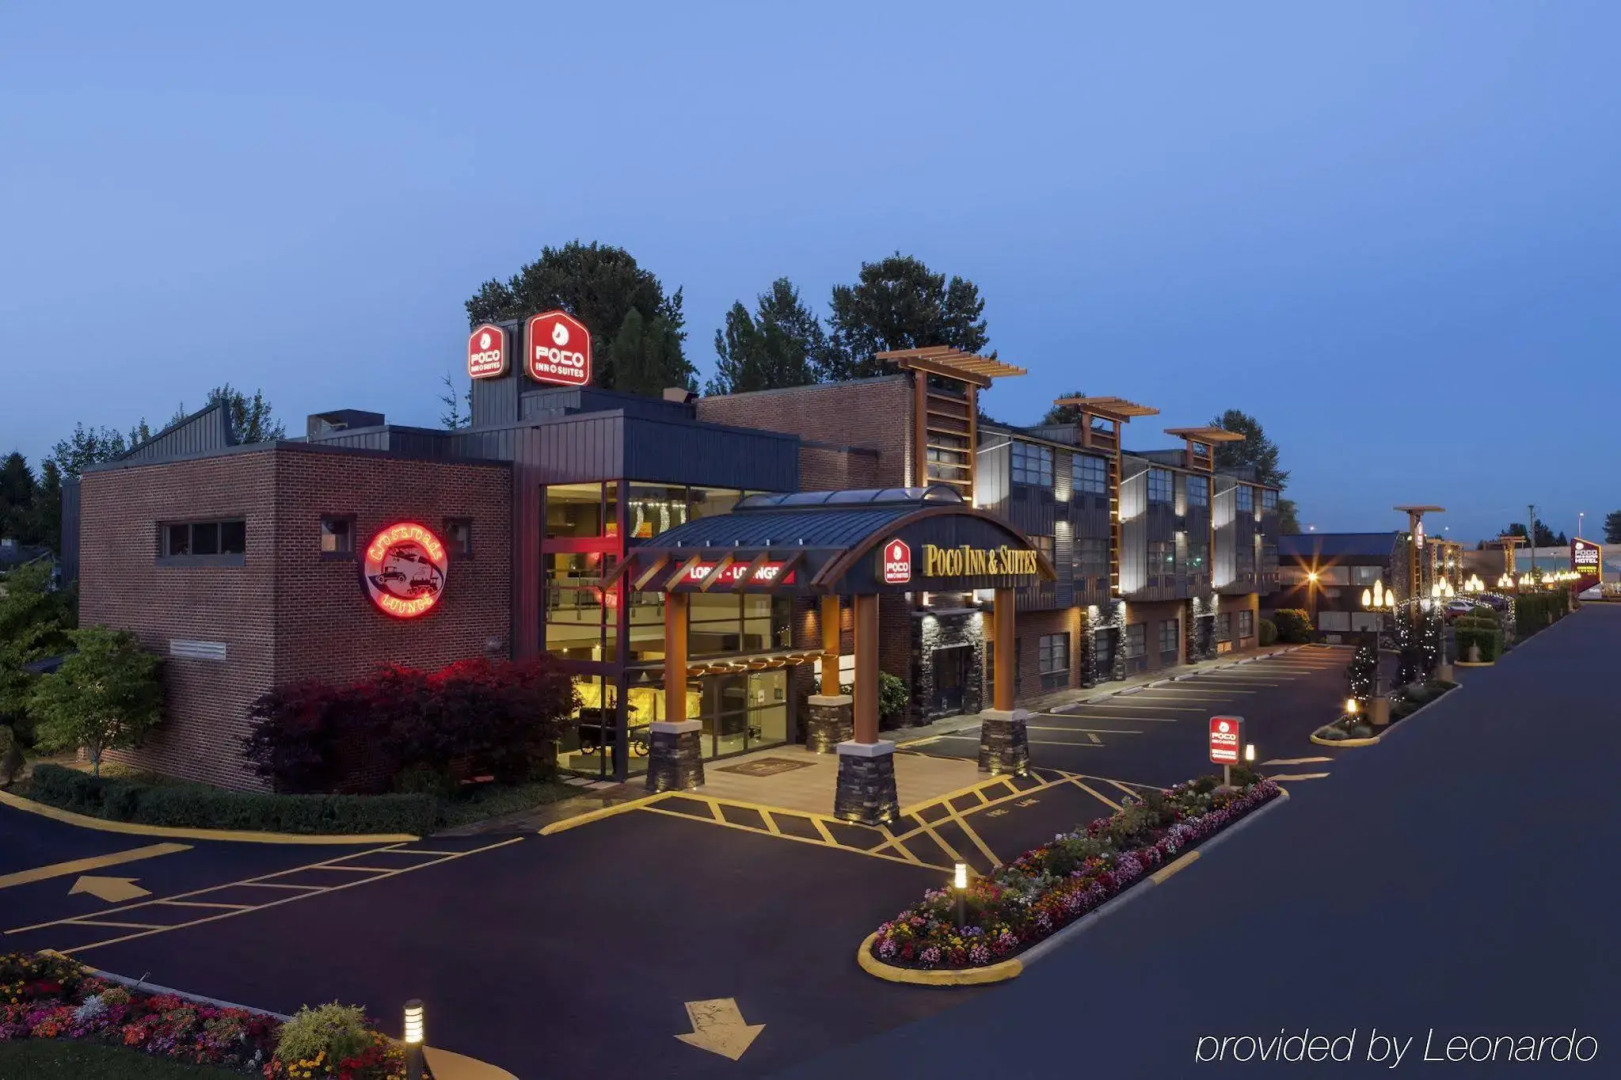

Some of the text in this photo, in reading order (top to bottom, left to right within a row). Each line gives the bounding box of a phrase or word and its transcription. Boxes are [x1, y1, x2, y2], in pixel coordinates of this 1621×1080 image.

[471, 349, 501, 365] POCO
[535, 345, 584, 368] POCO
[483, 361, 501, 371] SUITES
[535, 362, 584, 378] INN SUITES
[886, 562, 909, 572] POCO
[988, 549, 998, 575] &
[382, 593, 433, 613] LOUNGE
[1212, 732, 1236, 740] POCO
